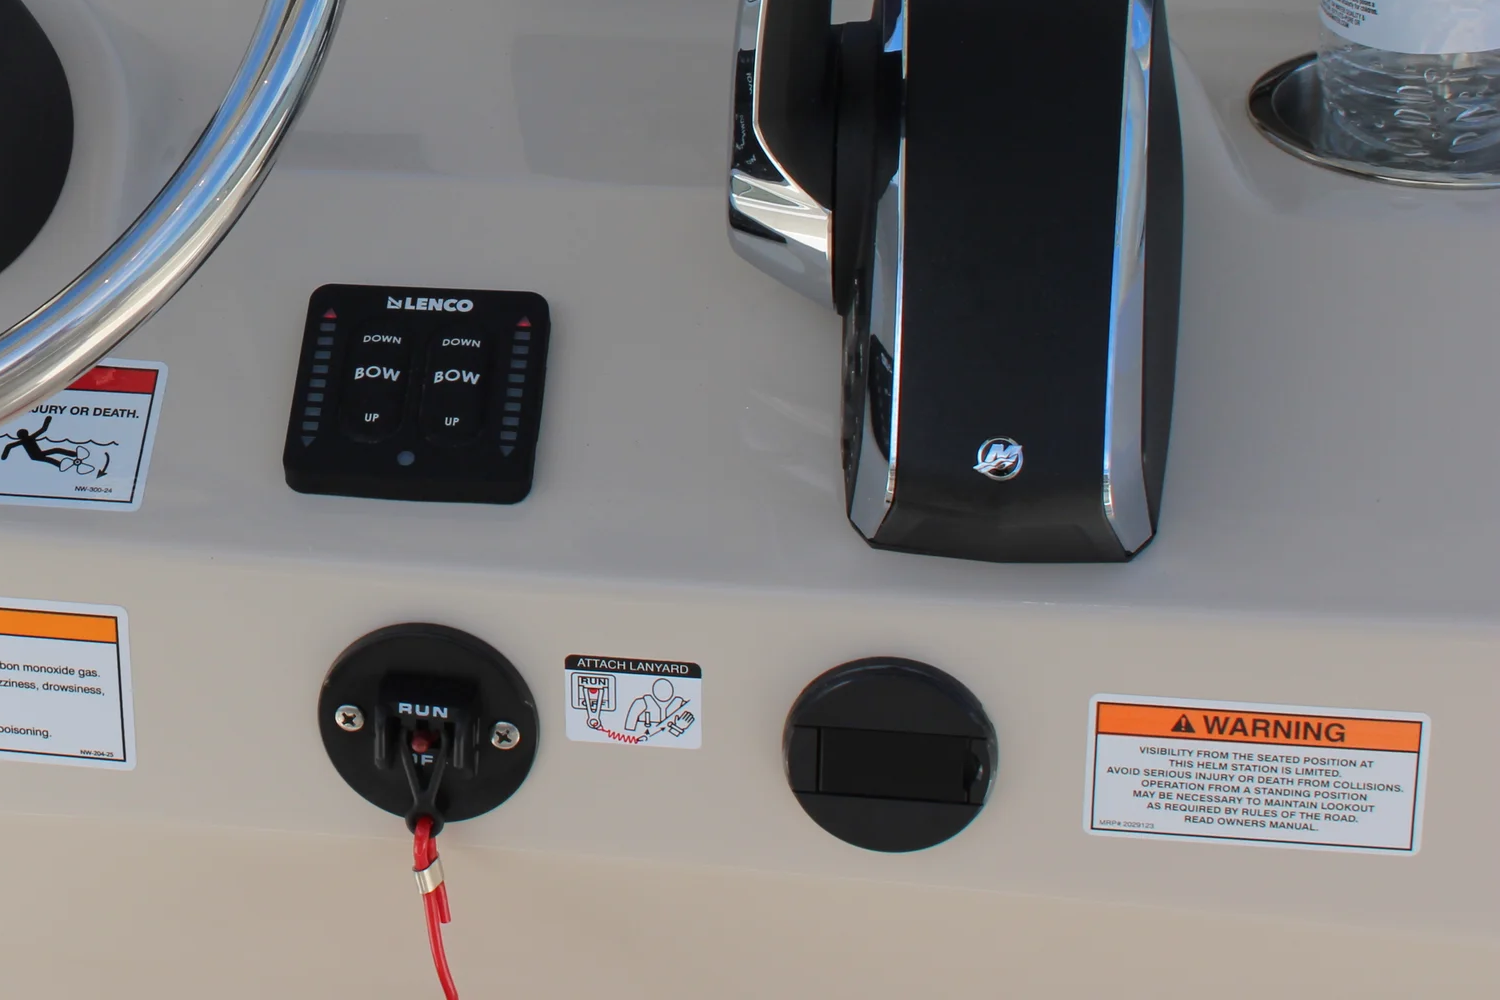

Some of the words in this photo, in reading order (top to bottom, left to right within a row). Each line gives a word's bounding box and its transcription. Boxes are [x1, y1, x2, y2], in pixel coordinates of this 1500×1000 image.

[404, 297, 474, 312] LENCO
[362, 334, 402, 344] DOWN
[442, 338, 481, 348] DOWN
[354, 365, 400, 382] BOW
[433, 369, 480, 385] BOW
[70, 406, 89, 416] OR
[92, 408, 140, 419] DEATH.
[364, 412, 380, 422] UP
[444, 417, 460, 427] UP
[74, 485, 113, 494] NW-300-24
[23, 664, 75, 676] monoxide
[78, 669, 100, 679] gas.
[577, 658, 626, 670] ATTACH
[629, 662, 689, 674] LANYARD
[42, 680, 105, 696] drowsiness,
[580, 678, 606, 686] RUN
[398, 702, 448, 718] RUN
[1203, 715, 1346, 742] WARNING
[80, 749, 114, 758] NW-204-25
[1139, 746, 1194, 757] VISIBILITY
[1197, 750, 1229, 759] FROM
[1232, 752, 1254, 761] THE
[1257, 753, 1300, 764] SEATED
[1303, 756, 1357, 767] POSITION
[1360, 760, 1374, 768] AT
[1169, 759, 1194, 768] THIS
[1197, 760, 1228, 770] HELM
[1231, 763, 1278, 773] STATION
[1281, 766, 1292, 774] IS
[1295, 767, 1342, 778] LIMITED.
[1107, 766, 1140, 776] AVOID
[1143, 768, 1192, 779] SERIOUS
[1196, 771, 1235, 782] INJURY
[1238, 774, 1254, 783] OR
[1258, 775, 1294, 785] DEATH
[1297, 778, 1330, 788] FROM
[1333, 780, 1404, 792] COLLISIONS.
[1184, 814, 1214, 824] READ
[1217, 817, 1266, 828] OWNERS
[1269, 820, 1319, 831] MANUAL.
